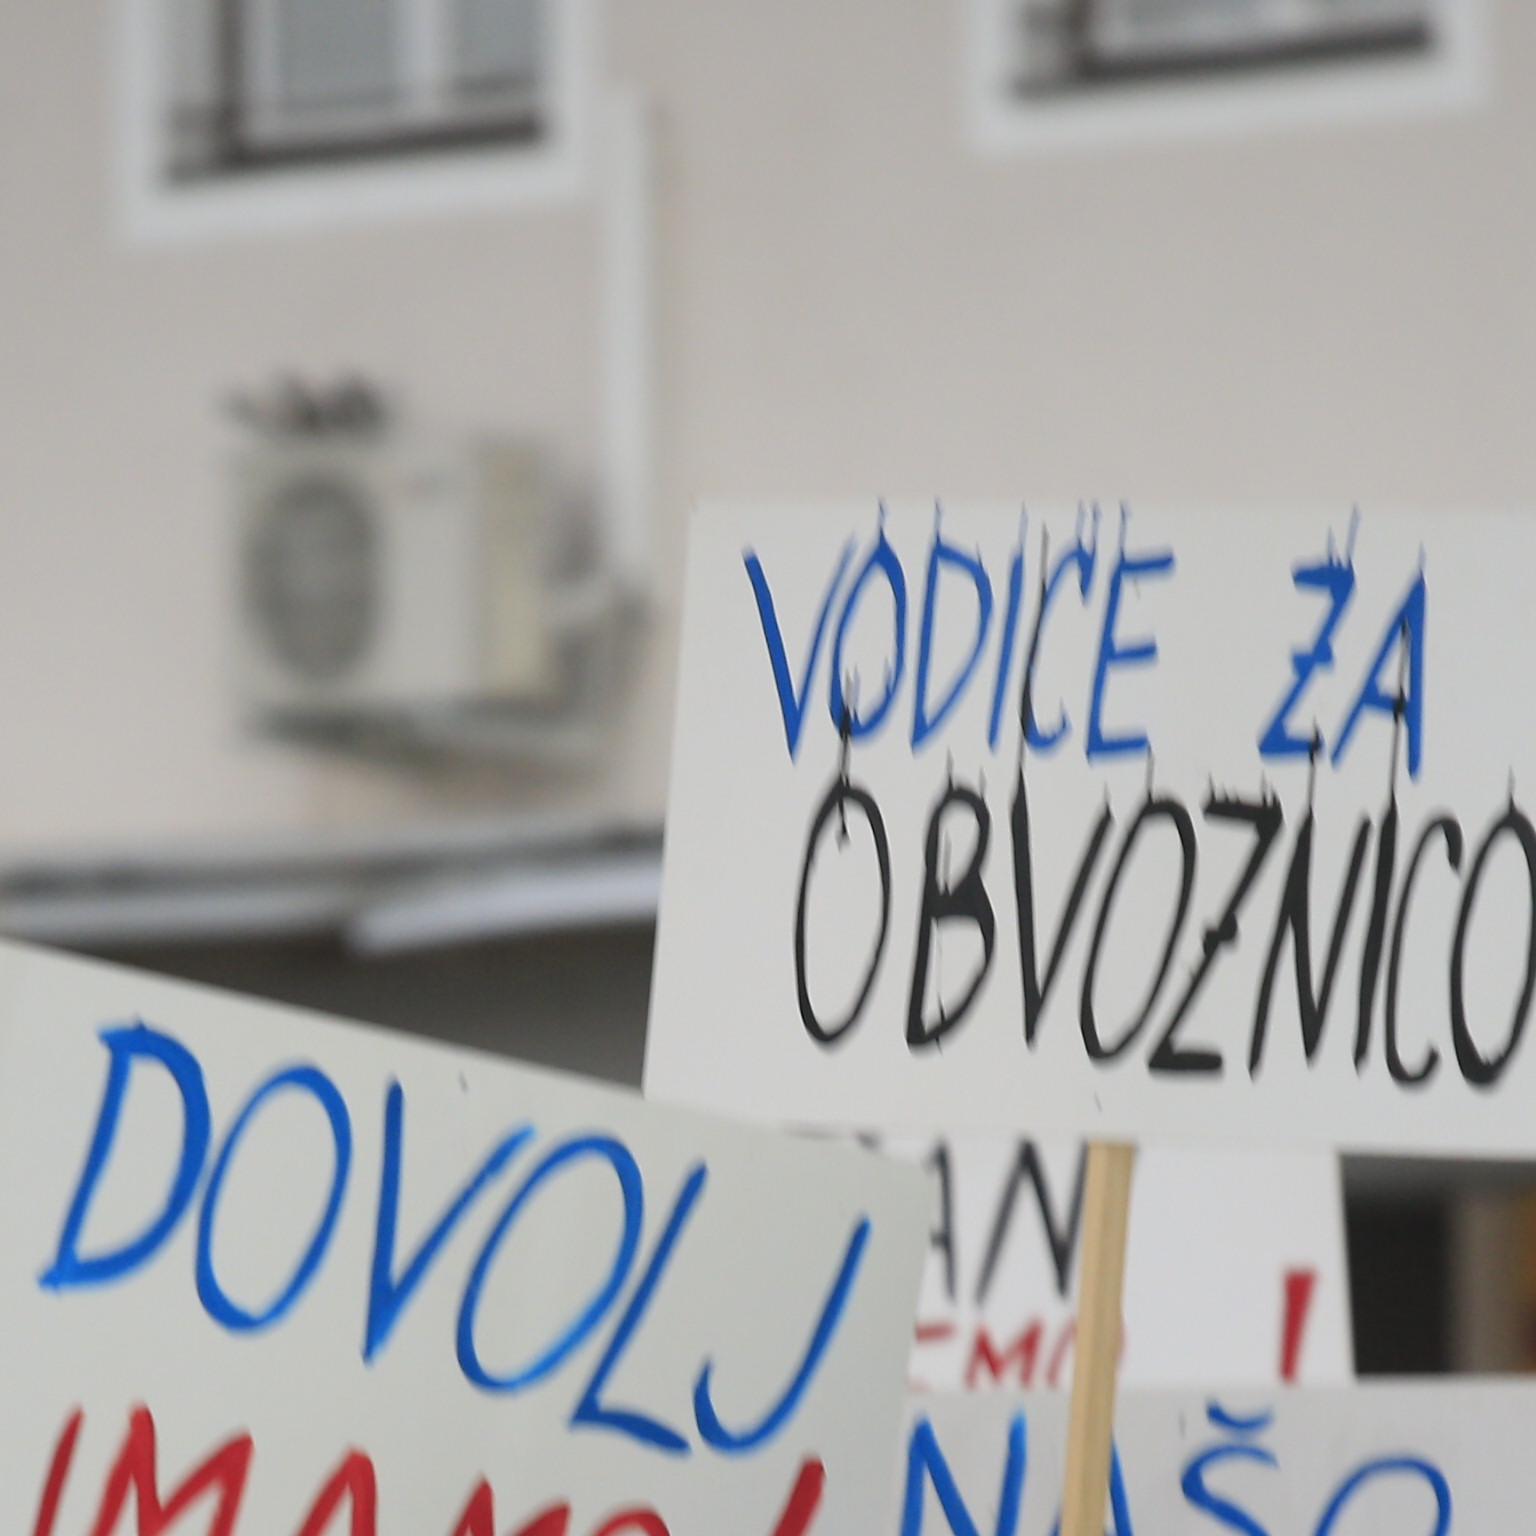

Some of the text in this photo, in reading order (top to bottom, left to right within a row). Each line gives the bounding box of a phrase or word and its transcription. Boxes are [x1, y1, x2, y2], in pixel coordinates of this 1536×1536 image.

[744, 508, 1430, 780] VODICE ZA
[37, 1018, 871, 1459] DOVOLJ
